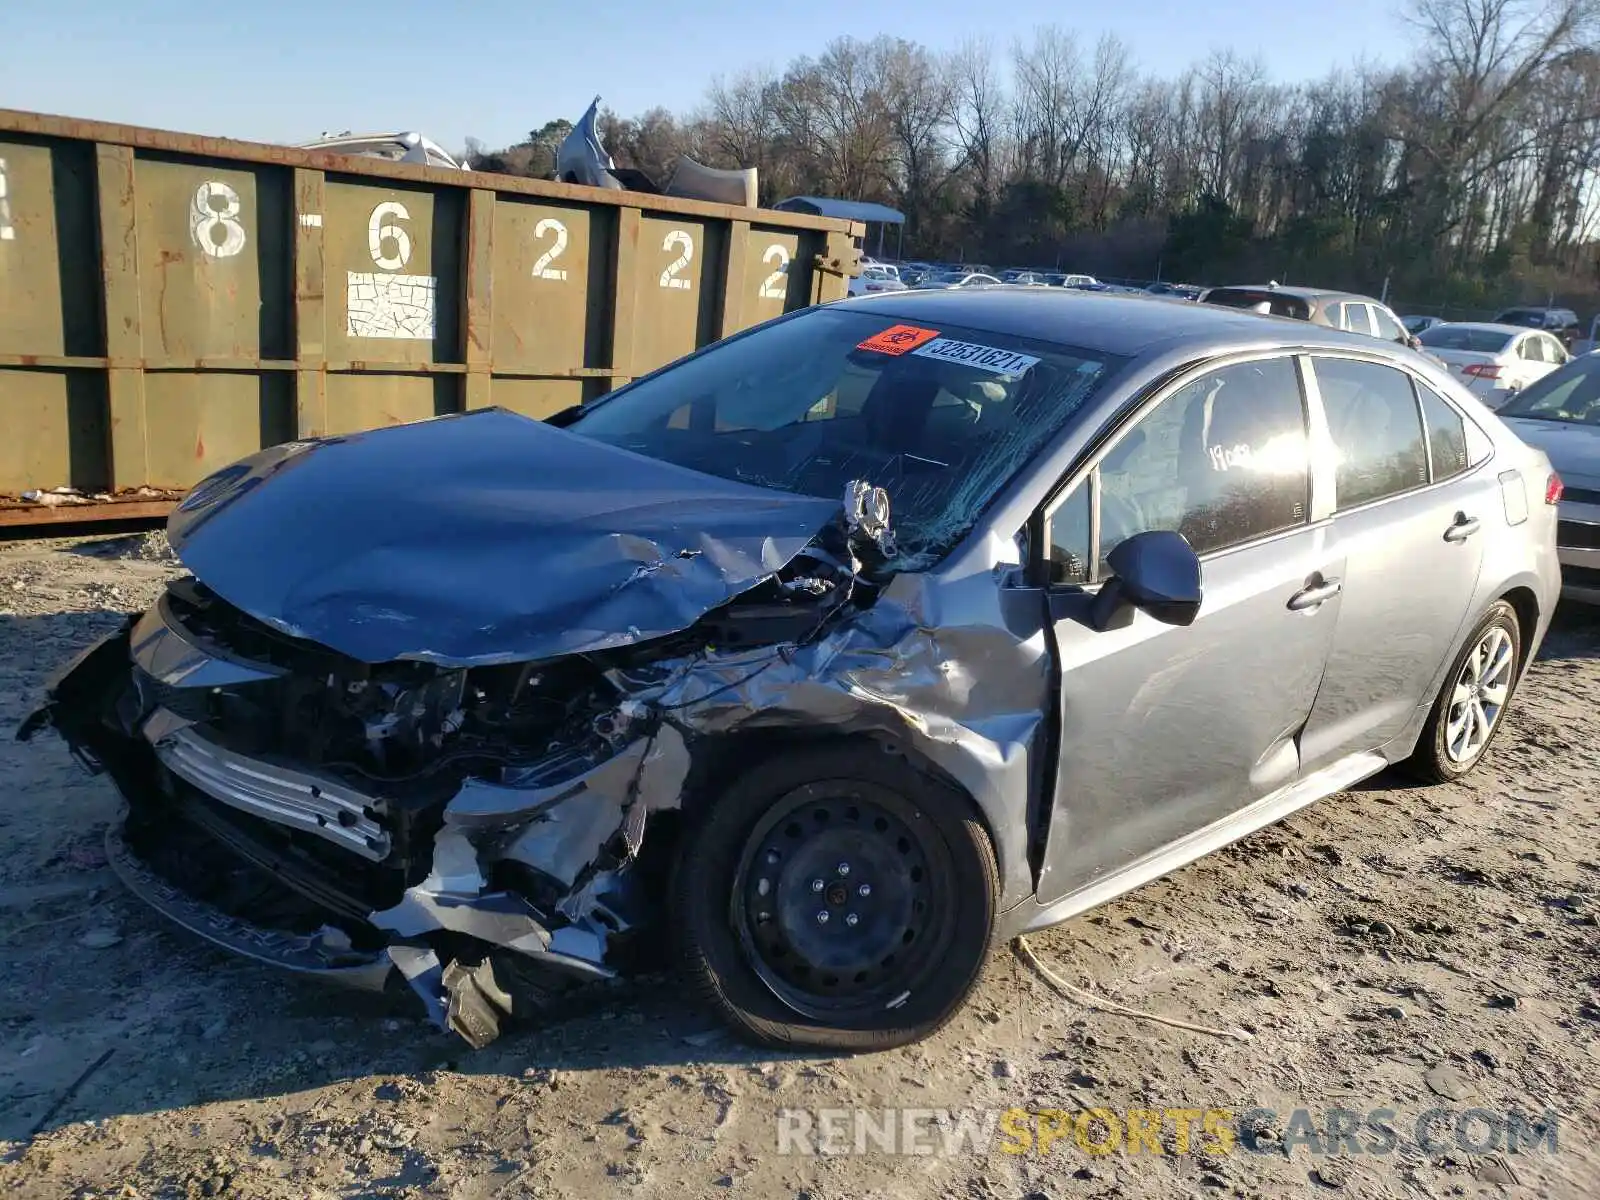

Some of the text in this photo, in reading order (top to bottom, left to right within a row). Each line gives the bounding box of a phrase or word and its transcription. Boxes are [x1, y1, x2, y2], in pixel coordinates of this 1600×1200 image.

[189, 181, 245, 257] 8
[368, 201, 411, 270] 6
[532, 218, 568, 280] 2
[659, 230, 694, 289] 2
[758, 244, 790, 299] 2
